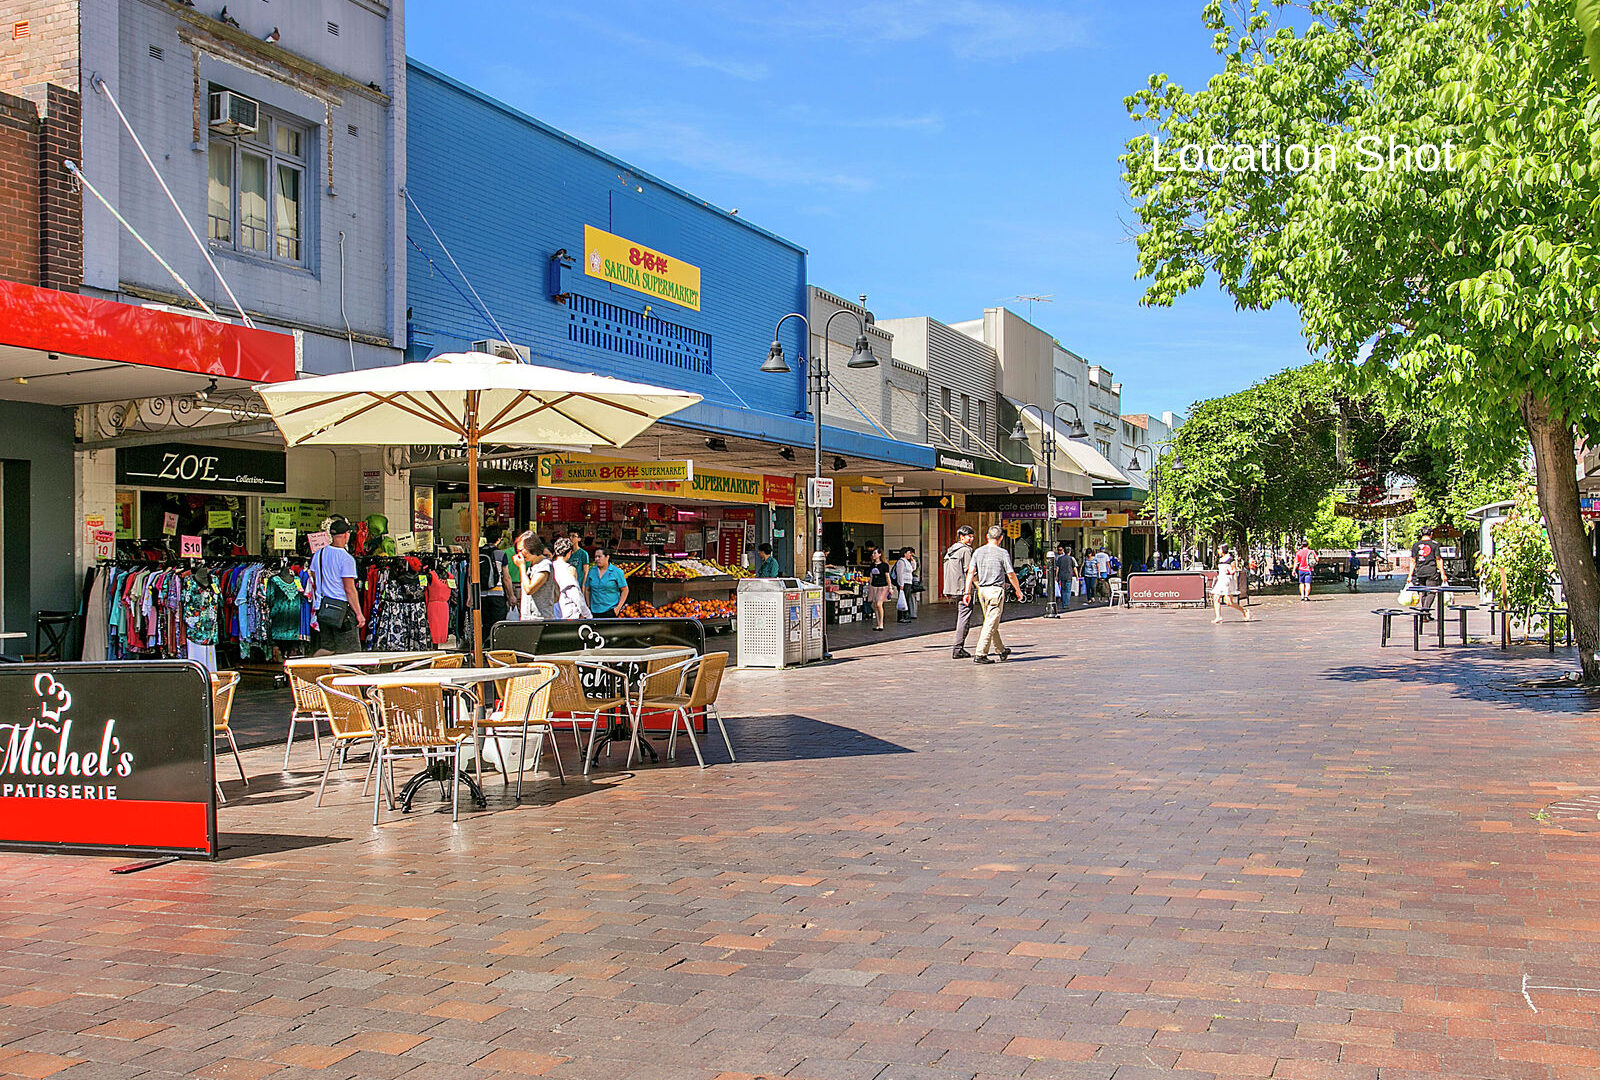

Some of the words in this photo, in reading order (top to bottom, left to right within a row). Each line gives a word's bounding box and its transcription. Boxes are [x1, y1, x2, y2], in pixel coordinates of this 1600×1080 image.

[604, 259, 640, 286] SAKURA
[642, 273, 698, 306] SUPERMARKET
[158, 453, 218, 481] ZOE
[568, 469, 597, 478] SAKURA
[640, 465, 686, 477] SUPERMARKET
[235, 475, 264, 484] Collections
[692, 473, 761, 496] SUPERMARKET
[1020, 502, 1046, 510] centro
[184, 542, 200, 553] $10
[1133, 590, 1152, 598] café
[1153, 590, 1180, 598] centro
[0, 717, 134, 778] Michel's
[3, 783, 118, 800] PATISSERIE
